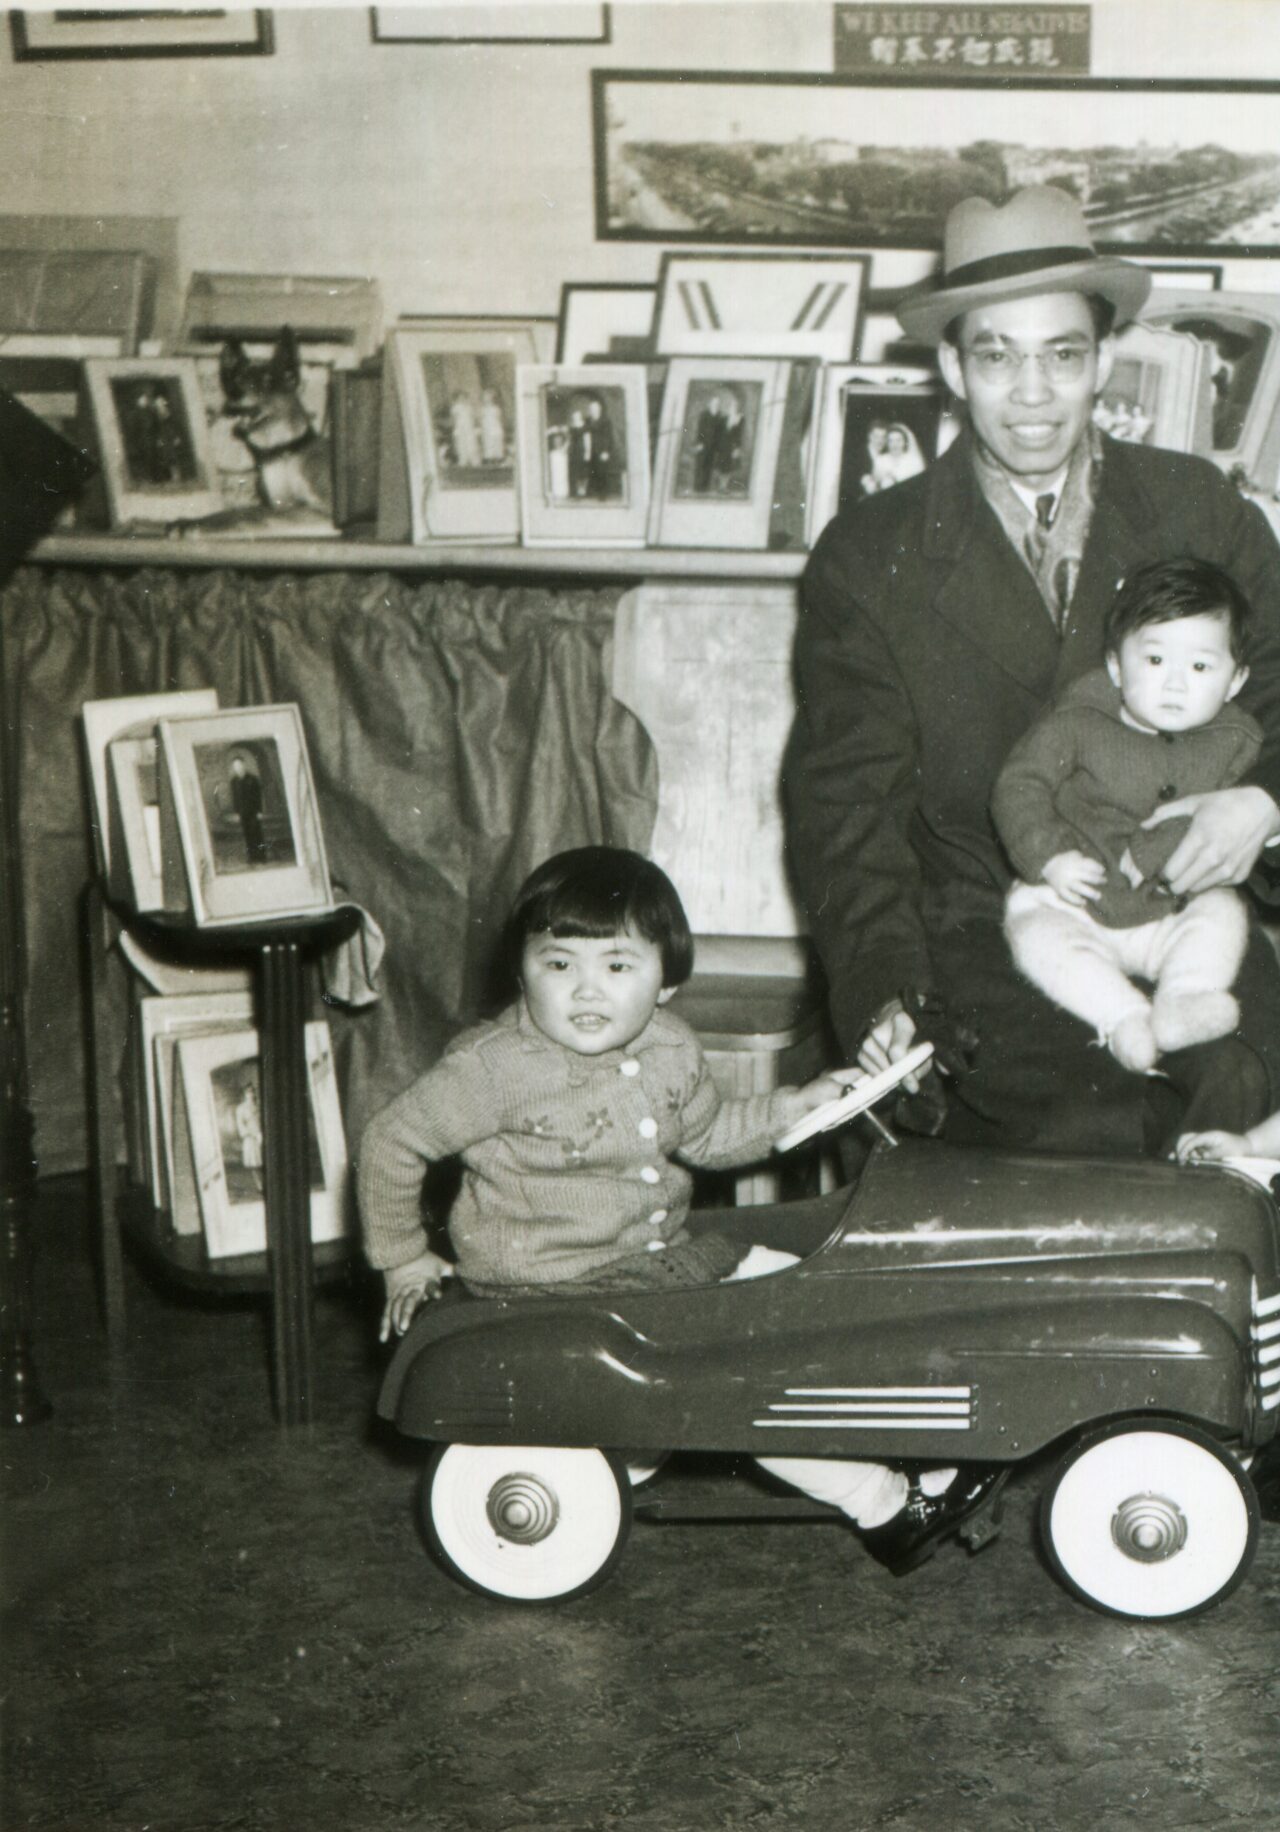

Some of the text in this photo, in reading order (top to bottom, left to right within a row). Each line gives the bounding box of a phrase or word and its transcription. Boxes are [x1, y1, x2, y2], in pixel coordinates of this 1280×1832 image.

[842, 11, 1089, 33] WE KEEP ALL NEGATIVES
